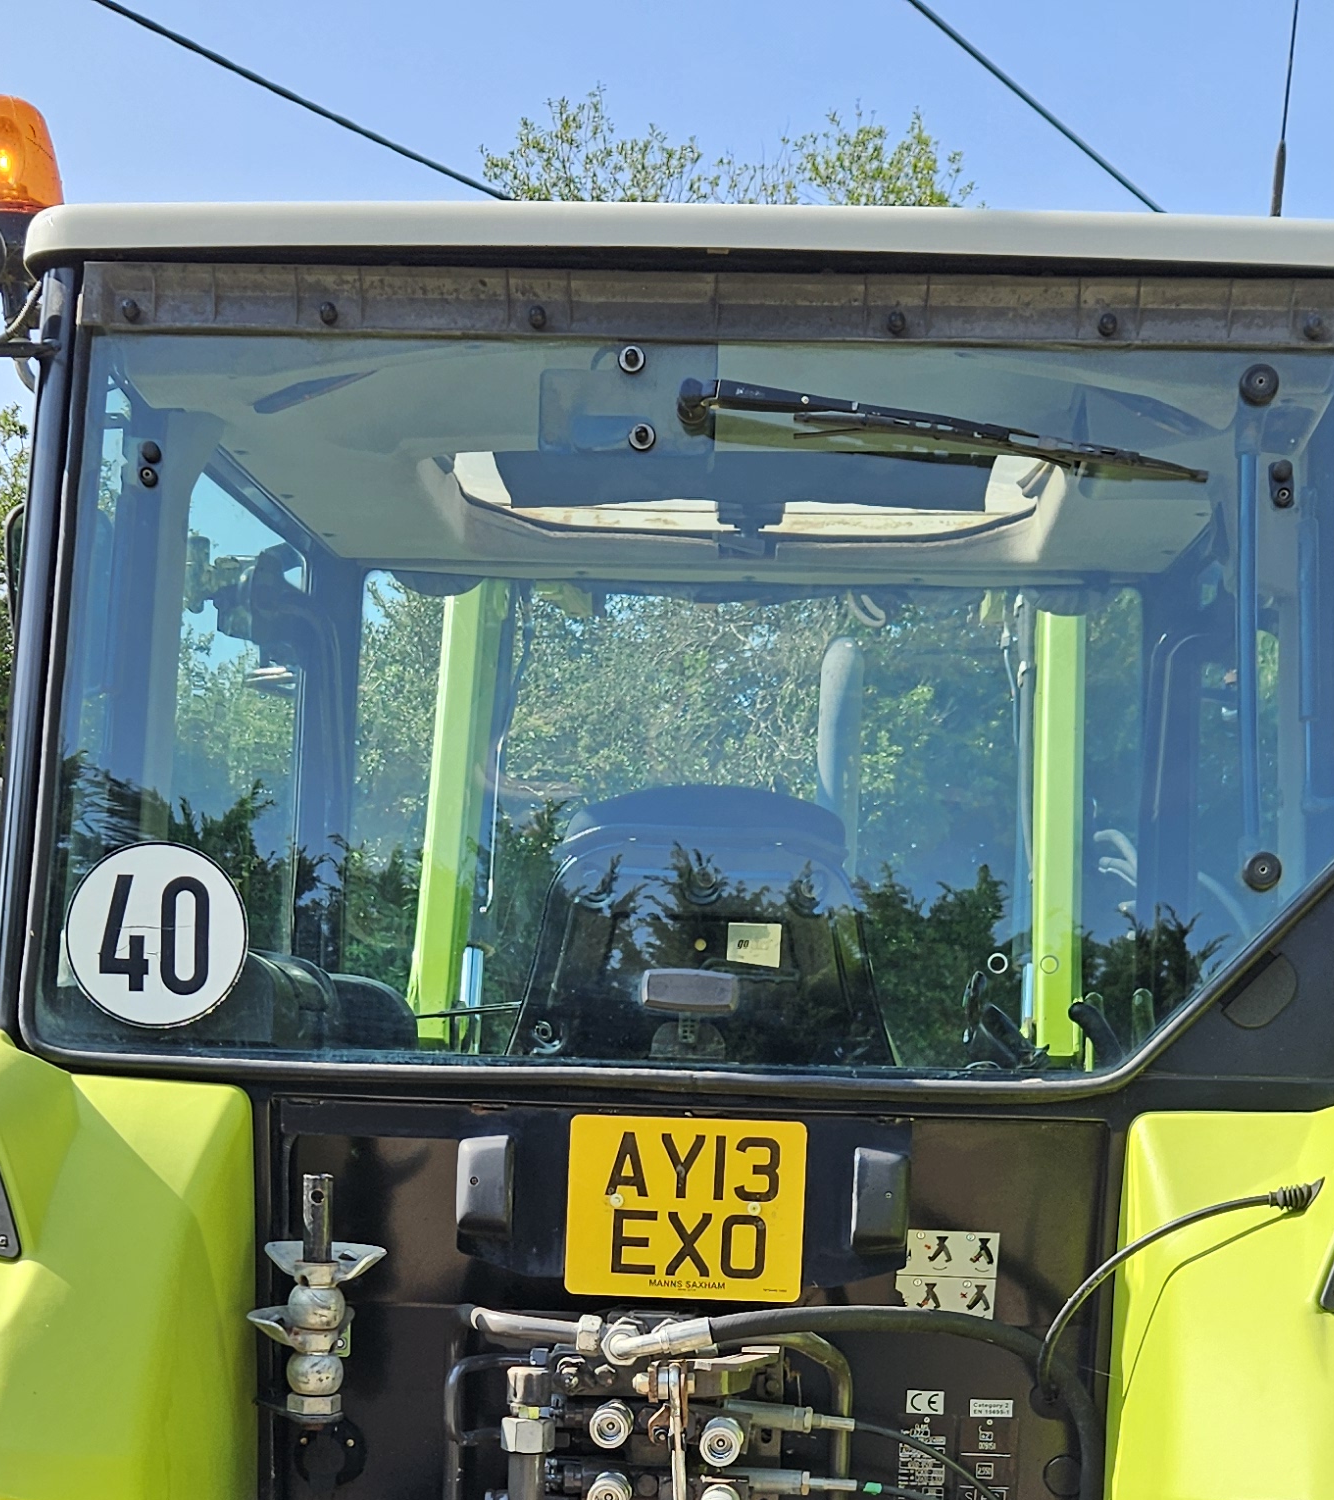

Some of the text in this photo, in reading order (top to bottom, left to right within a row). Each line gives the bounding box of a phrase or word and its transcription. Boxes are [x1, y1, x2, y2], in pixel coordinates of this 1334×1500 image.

[99, 874, 210, 996] 40
[604, 1131, 781, 1203] AY13
[610, 1208, 767, 1280] EXO
[648, 1279, 726, 1290] MANNS SAXHAM
[910, 1392, 940, 1412] CE
